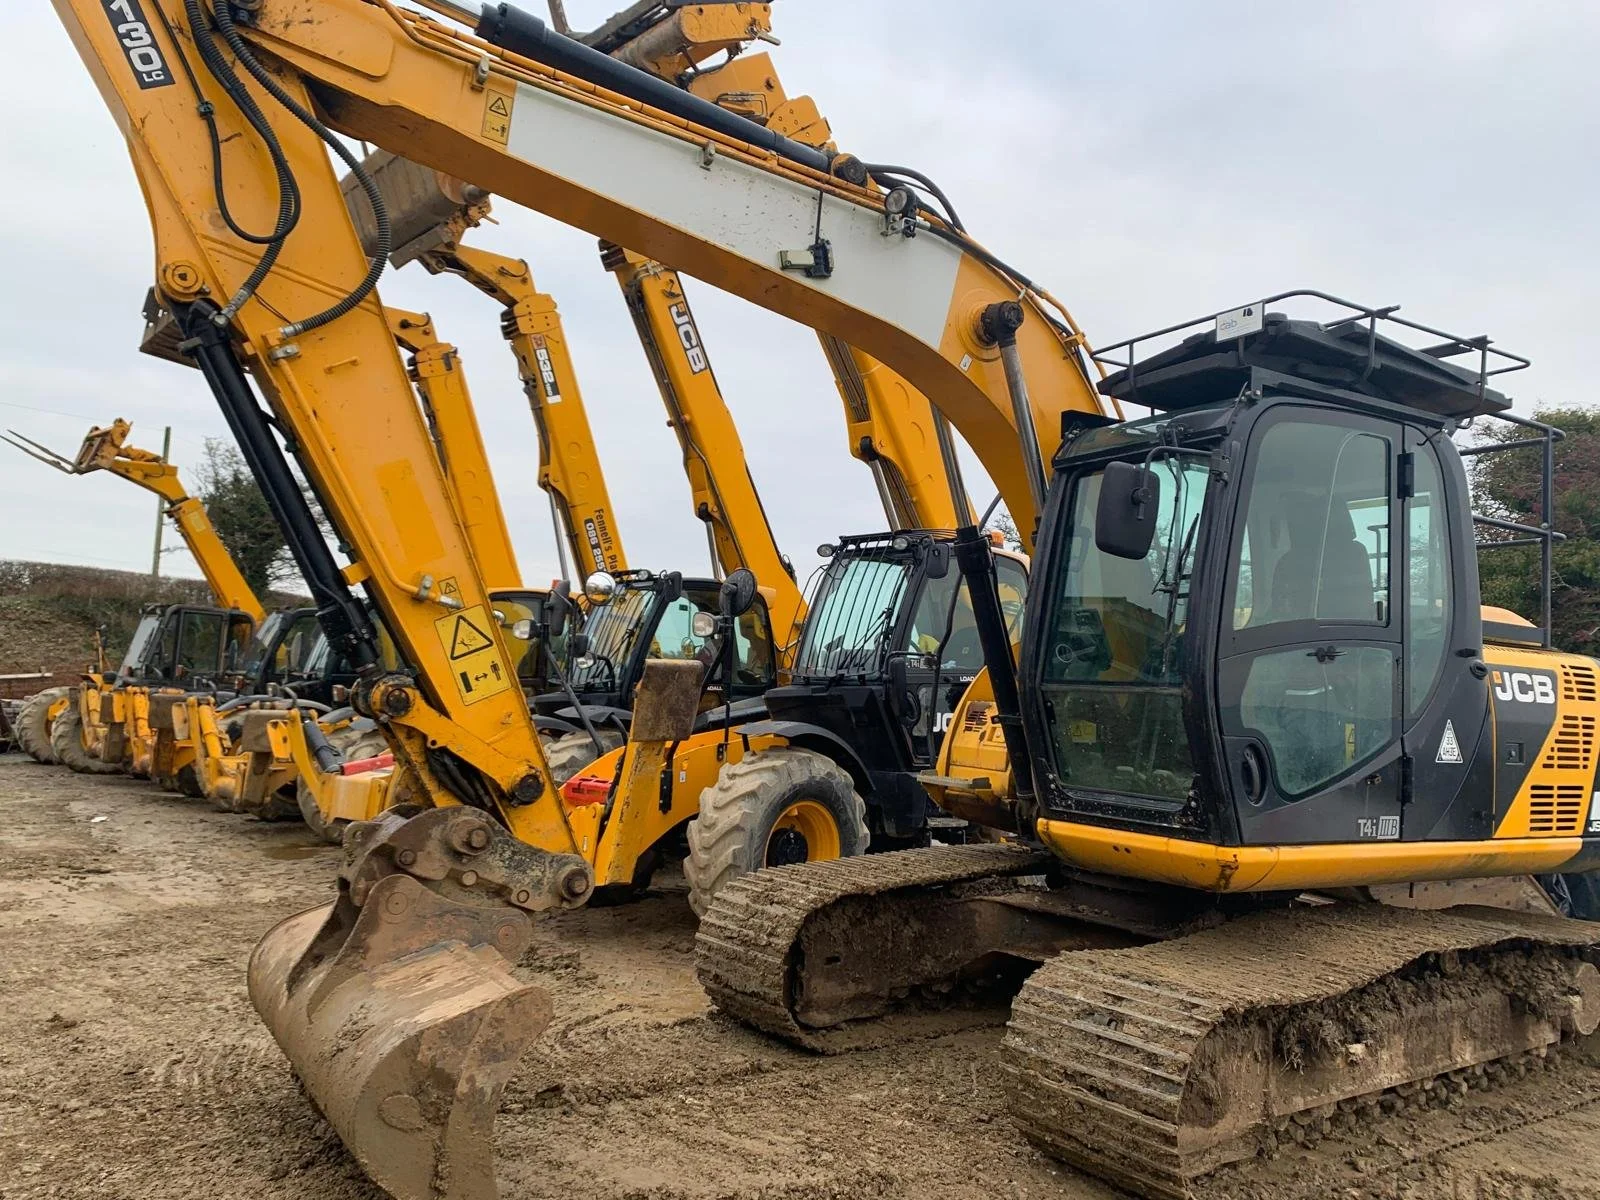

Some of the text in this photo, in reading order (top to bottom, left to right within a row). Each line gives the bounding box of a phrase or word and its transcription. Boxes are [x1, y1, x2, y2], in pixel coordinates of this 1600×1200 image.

[670, 302, 706, 373] JCB
[594, 508, 619, 572] Fennell's Pla
[1492, 670, 1555, 704] JCB
